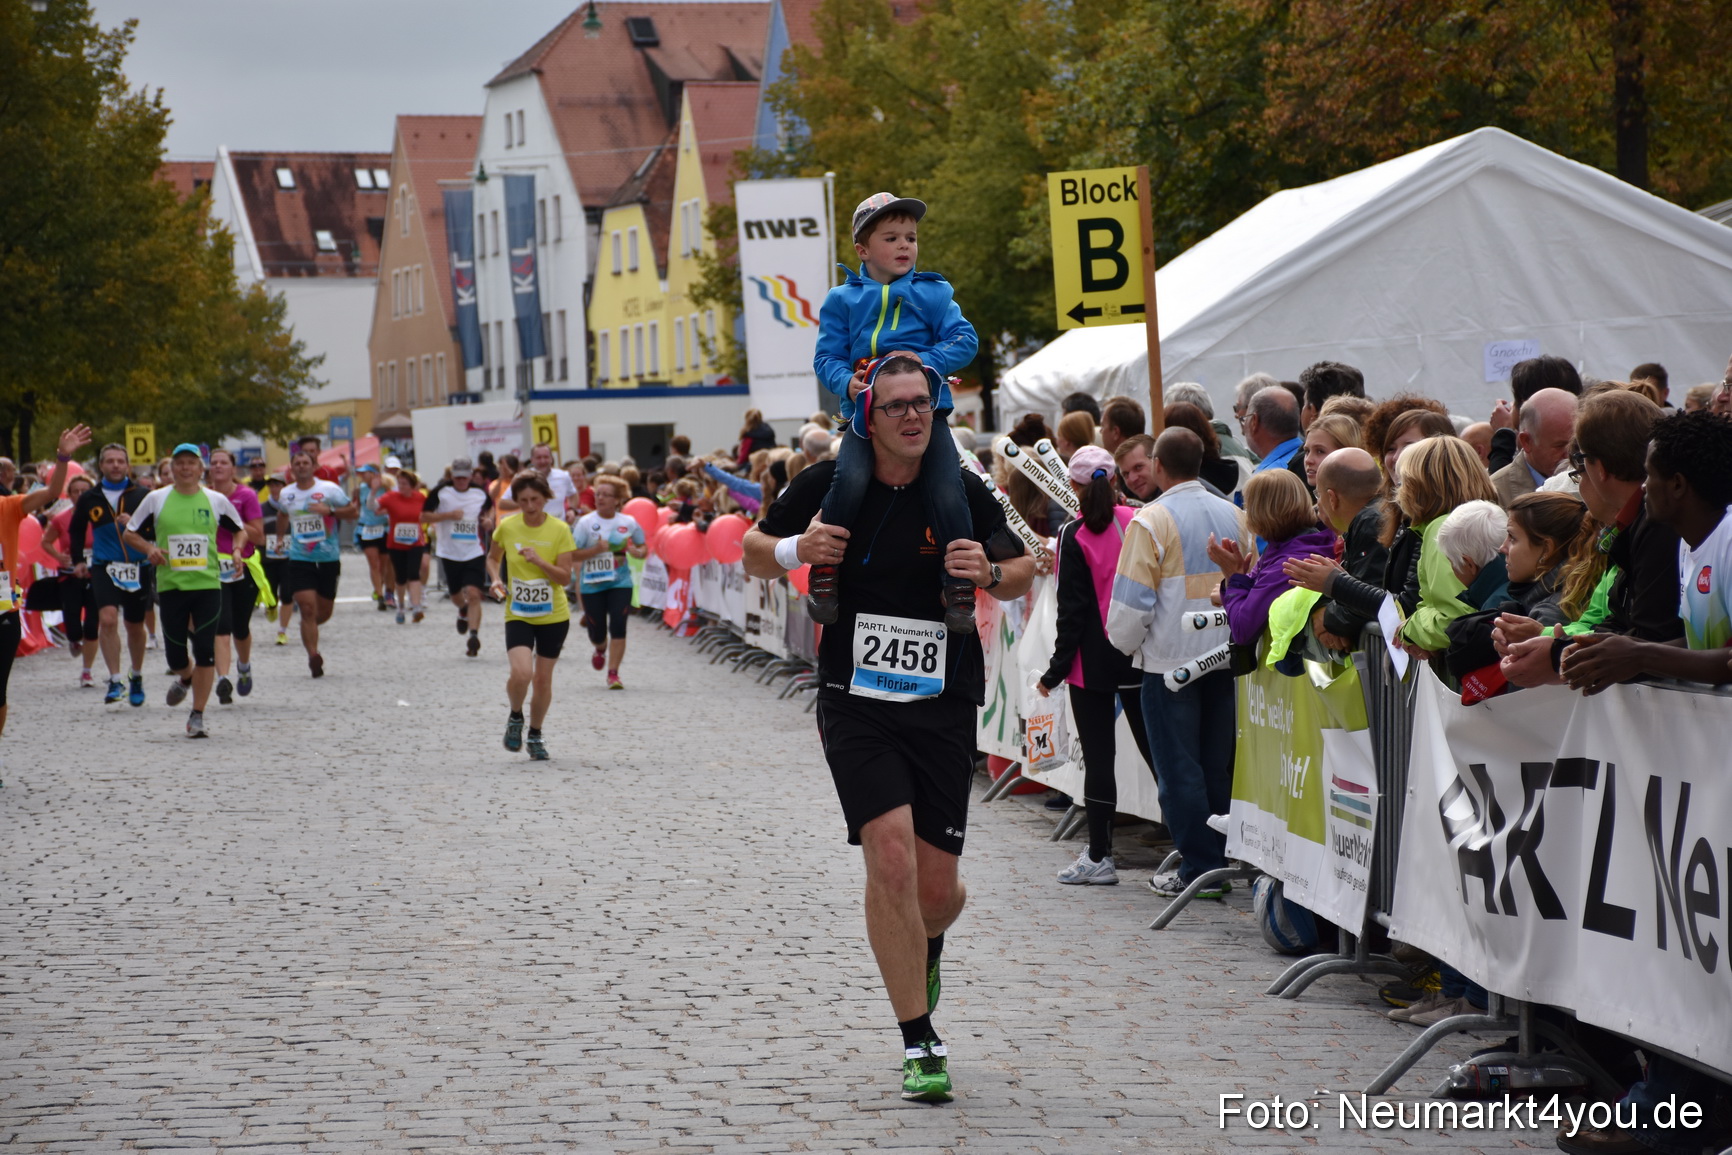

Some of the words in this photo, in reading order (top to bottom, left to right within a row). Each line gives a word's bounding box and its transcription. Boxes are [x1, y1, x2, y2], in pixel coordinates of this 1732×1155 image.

[1061, 174, 1139, 206] Block
[1077, 217, 1130, 293] B
[538, 426, 553, 445] D
[134, 436, 148, 457] D
[998, 496, 1022, 526] BMW
[296, 520, 322, 533] 2756
[177, 543, 201, 557] 243
[586, 558, 611, 573] 2100
[515, 586, 549, 602] 2325
[857, 621, 889, 633] PARTL
[890, 625, 933, 638] Neumarkt
[862, 635, 938, 674] 2458
[876, 675, 918, 692] Florian
[1644, 774, 1732, 975] Ne
